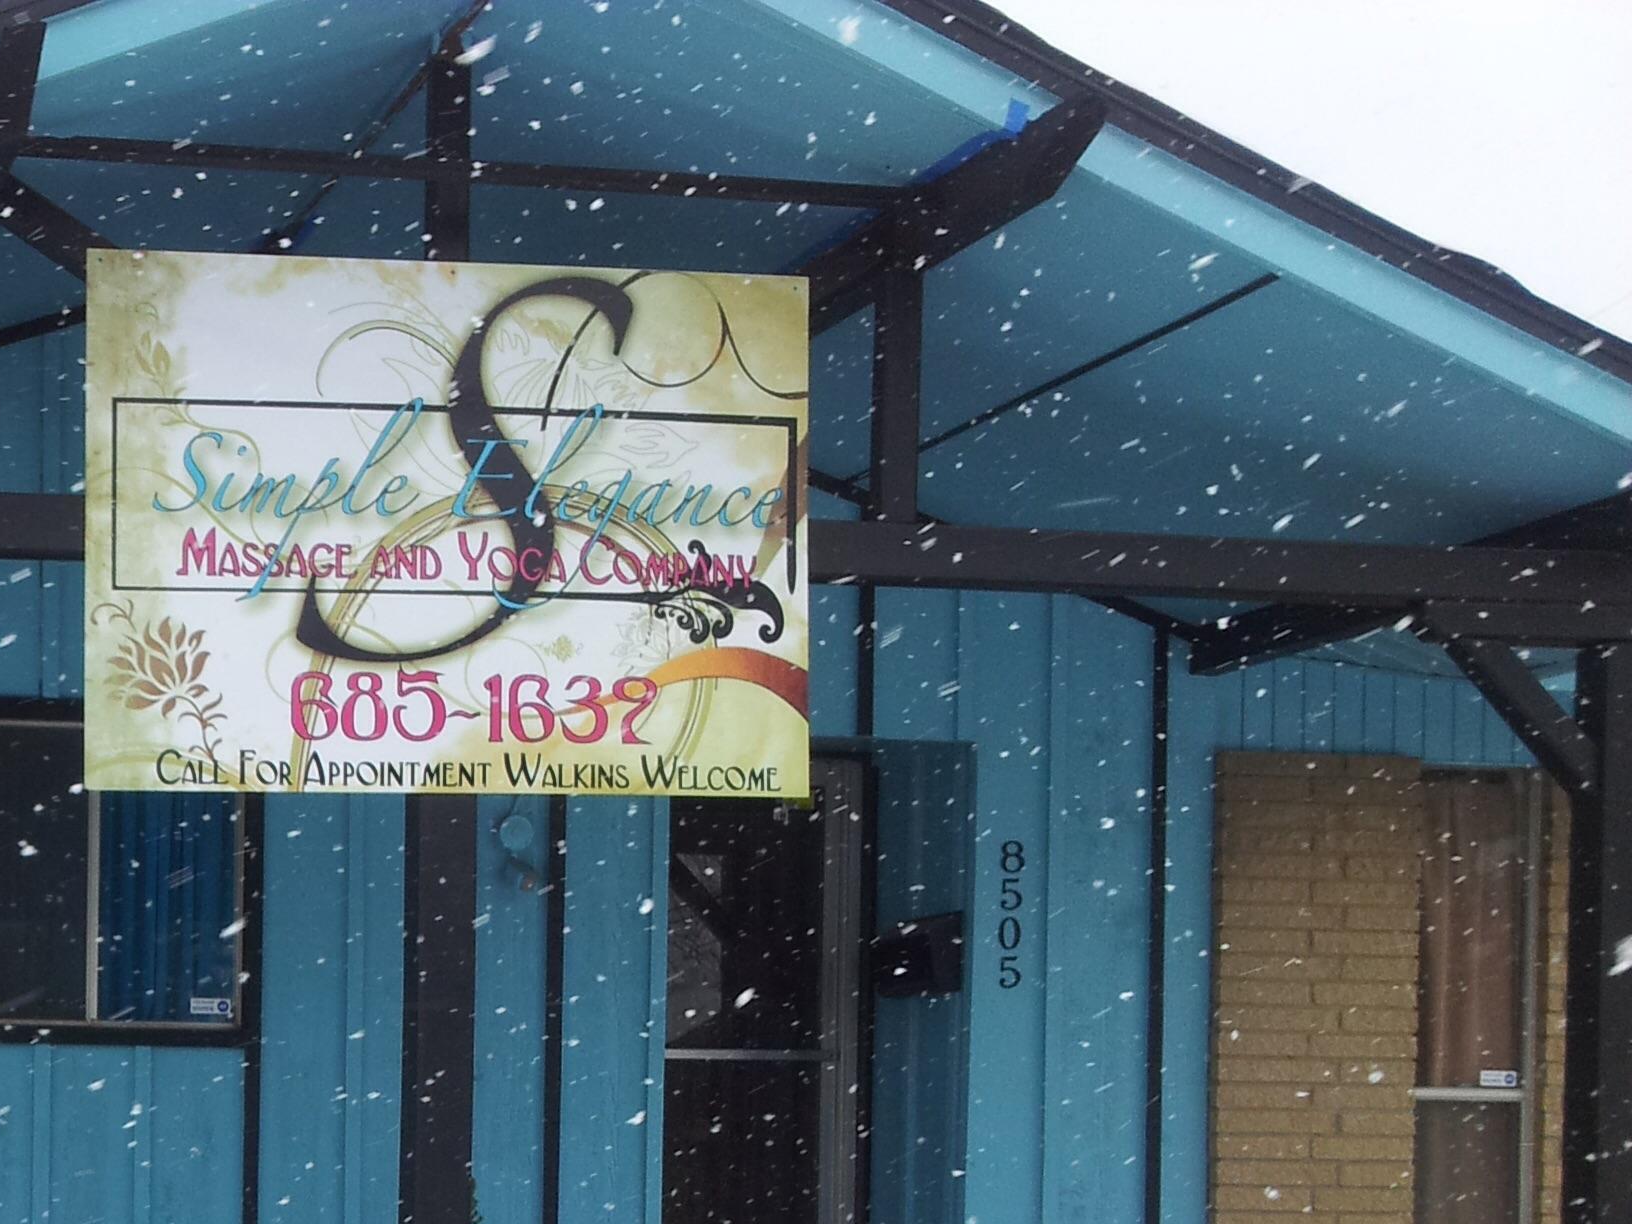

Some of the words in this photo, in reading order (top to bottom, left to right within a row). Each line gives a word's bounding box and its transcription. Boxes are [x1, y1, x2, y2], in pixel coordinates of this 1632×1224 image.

[152, 396, 424, 601] Simple
[452, 403, 786, 611] Elegance
[176, 526, 352, 580] MASSAGE
[369, 543, 443, 581] AND
[457, 531, 567, 583] YOGA
[579, 535, 758, 589] COMPANY
[156, 749, 229, 786] CALL
[239, 749, 292, 786] FOR
[303, 750, 492, 788] APPOINTMENT
[503, 752, 630, 789] WALKINS
[640, 754, 781, 792] WELCOME
[998, 840, 1025, 989] 8505
